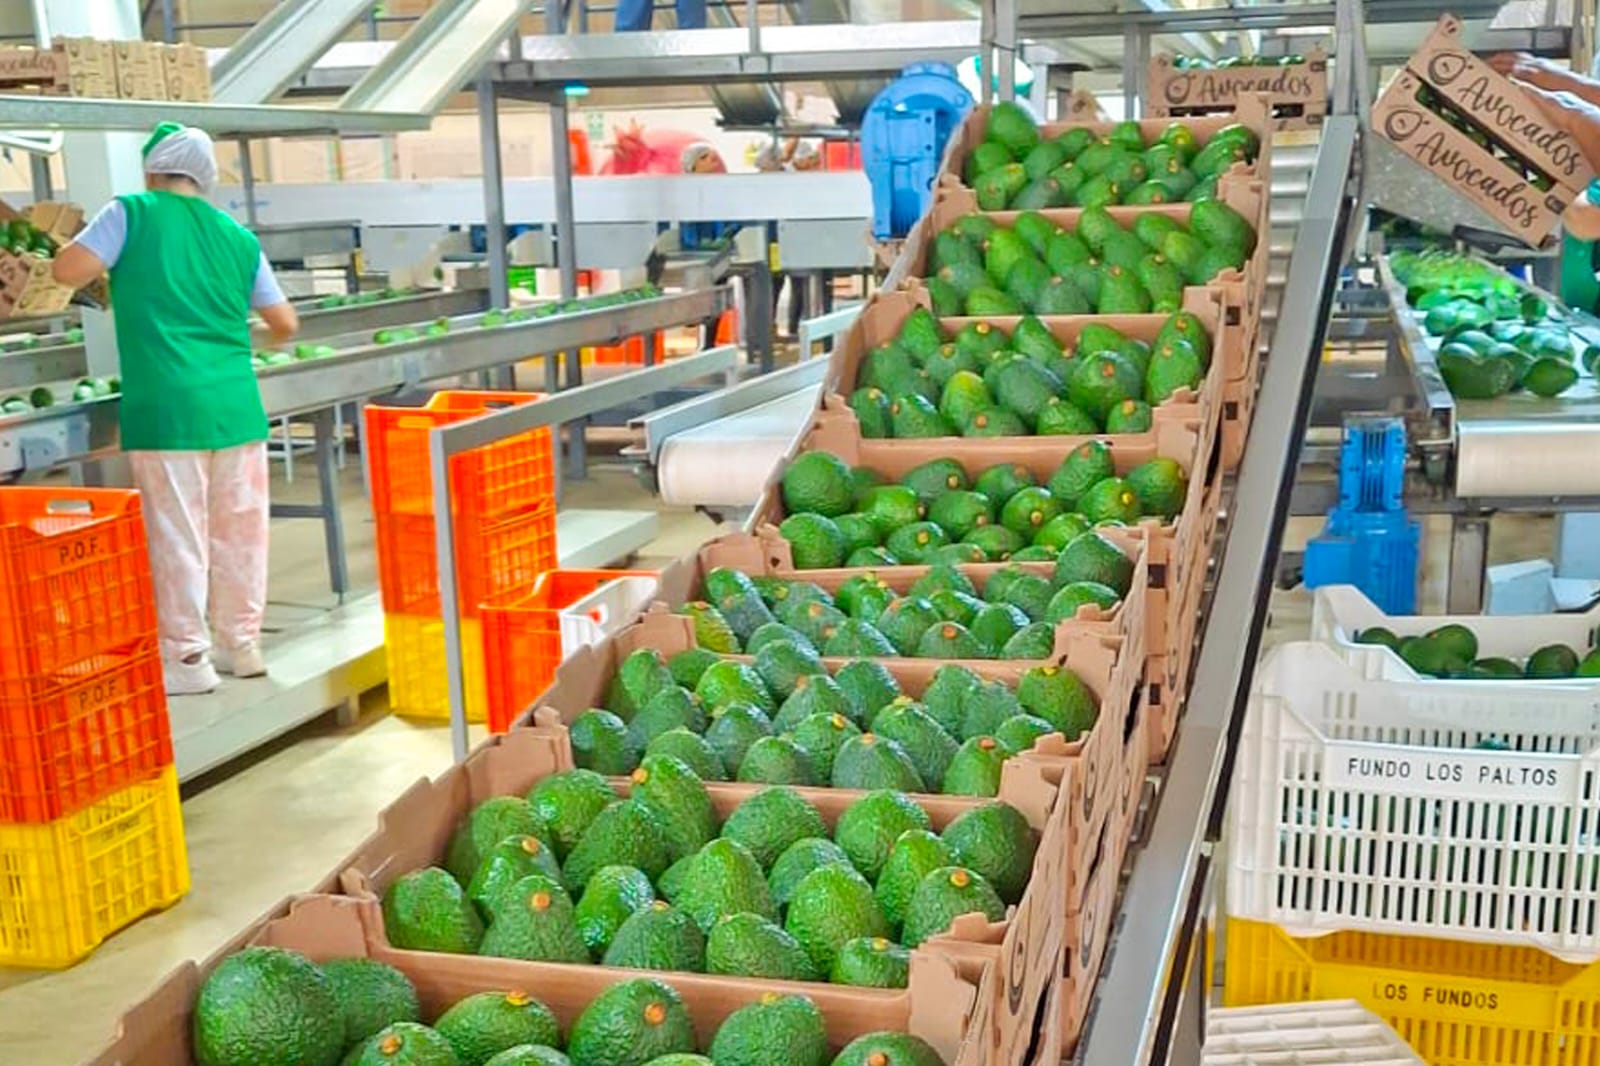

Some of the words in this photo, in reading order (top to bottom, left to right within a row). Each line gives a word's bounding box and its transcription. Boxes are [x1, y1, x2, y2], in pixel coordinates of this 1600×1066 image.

[1458, 77, 1582, 176] Avocados
[1416, 132, 1538, 228] Avocados
[1348, 758, 1411, 778] FUNDO
[1426, 763, 1463, 782] LOS
[1479, 766, 1557, 786] PALTOS
[1373, 983, 1408, 1001] LOS
[1423, 987, 1498, 1009] FUNDOS
